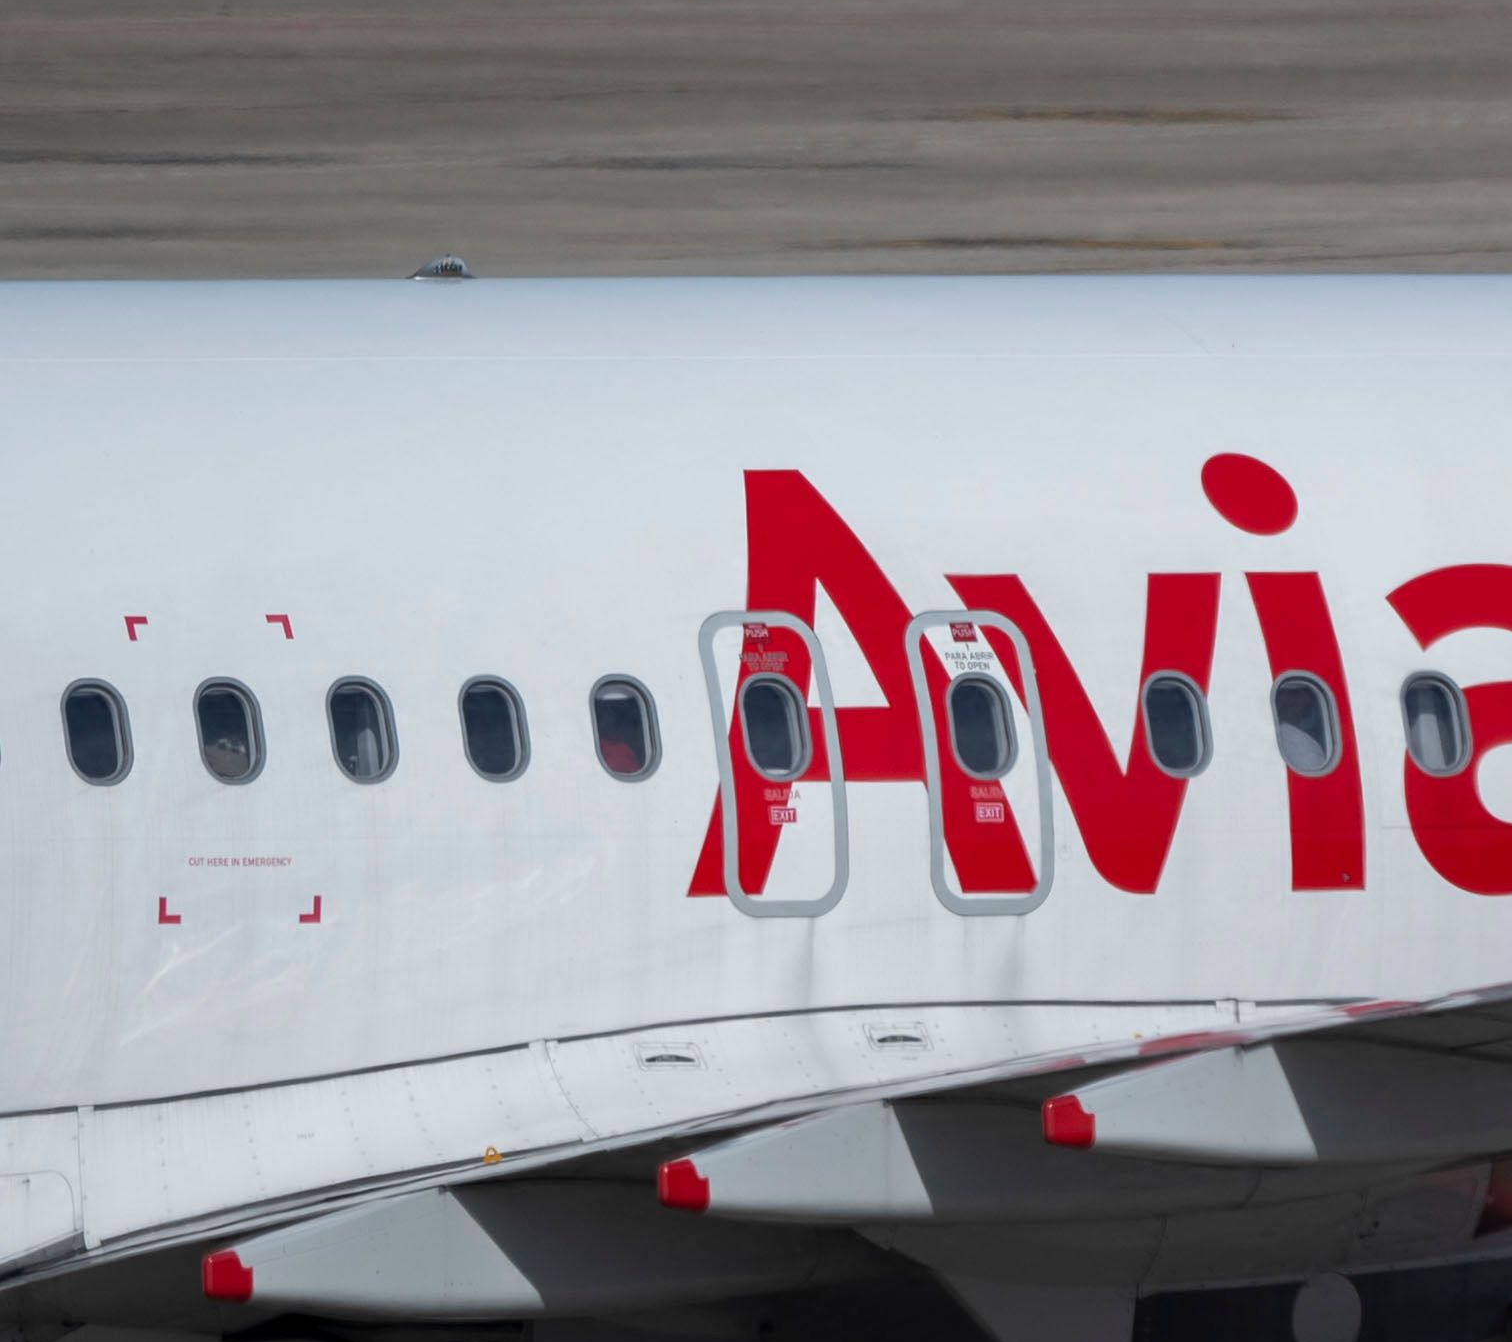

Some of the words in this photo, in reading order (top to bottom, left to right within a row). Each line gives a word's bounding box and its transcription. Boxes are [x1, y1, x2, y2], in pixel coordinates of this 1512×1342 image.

[952, 628, 976, 637] PUSH
[944, 652, 968, 661] PARA
[954, 661, 966, 670] TO
[967, 662, 990, 670] OPEN
[773, 810, 795, 821] EXIT
[979, 807, 1001, 818] EXIT
[188, 857, 205, 866] CUT
[206, 857, 229, 867] HERE
[242, 857, 293, 867] EMERGENCY
